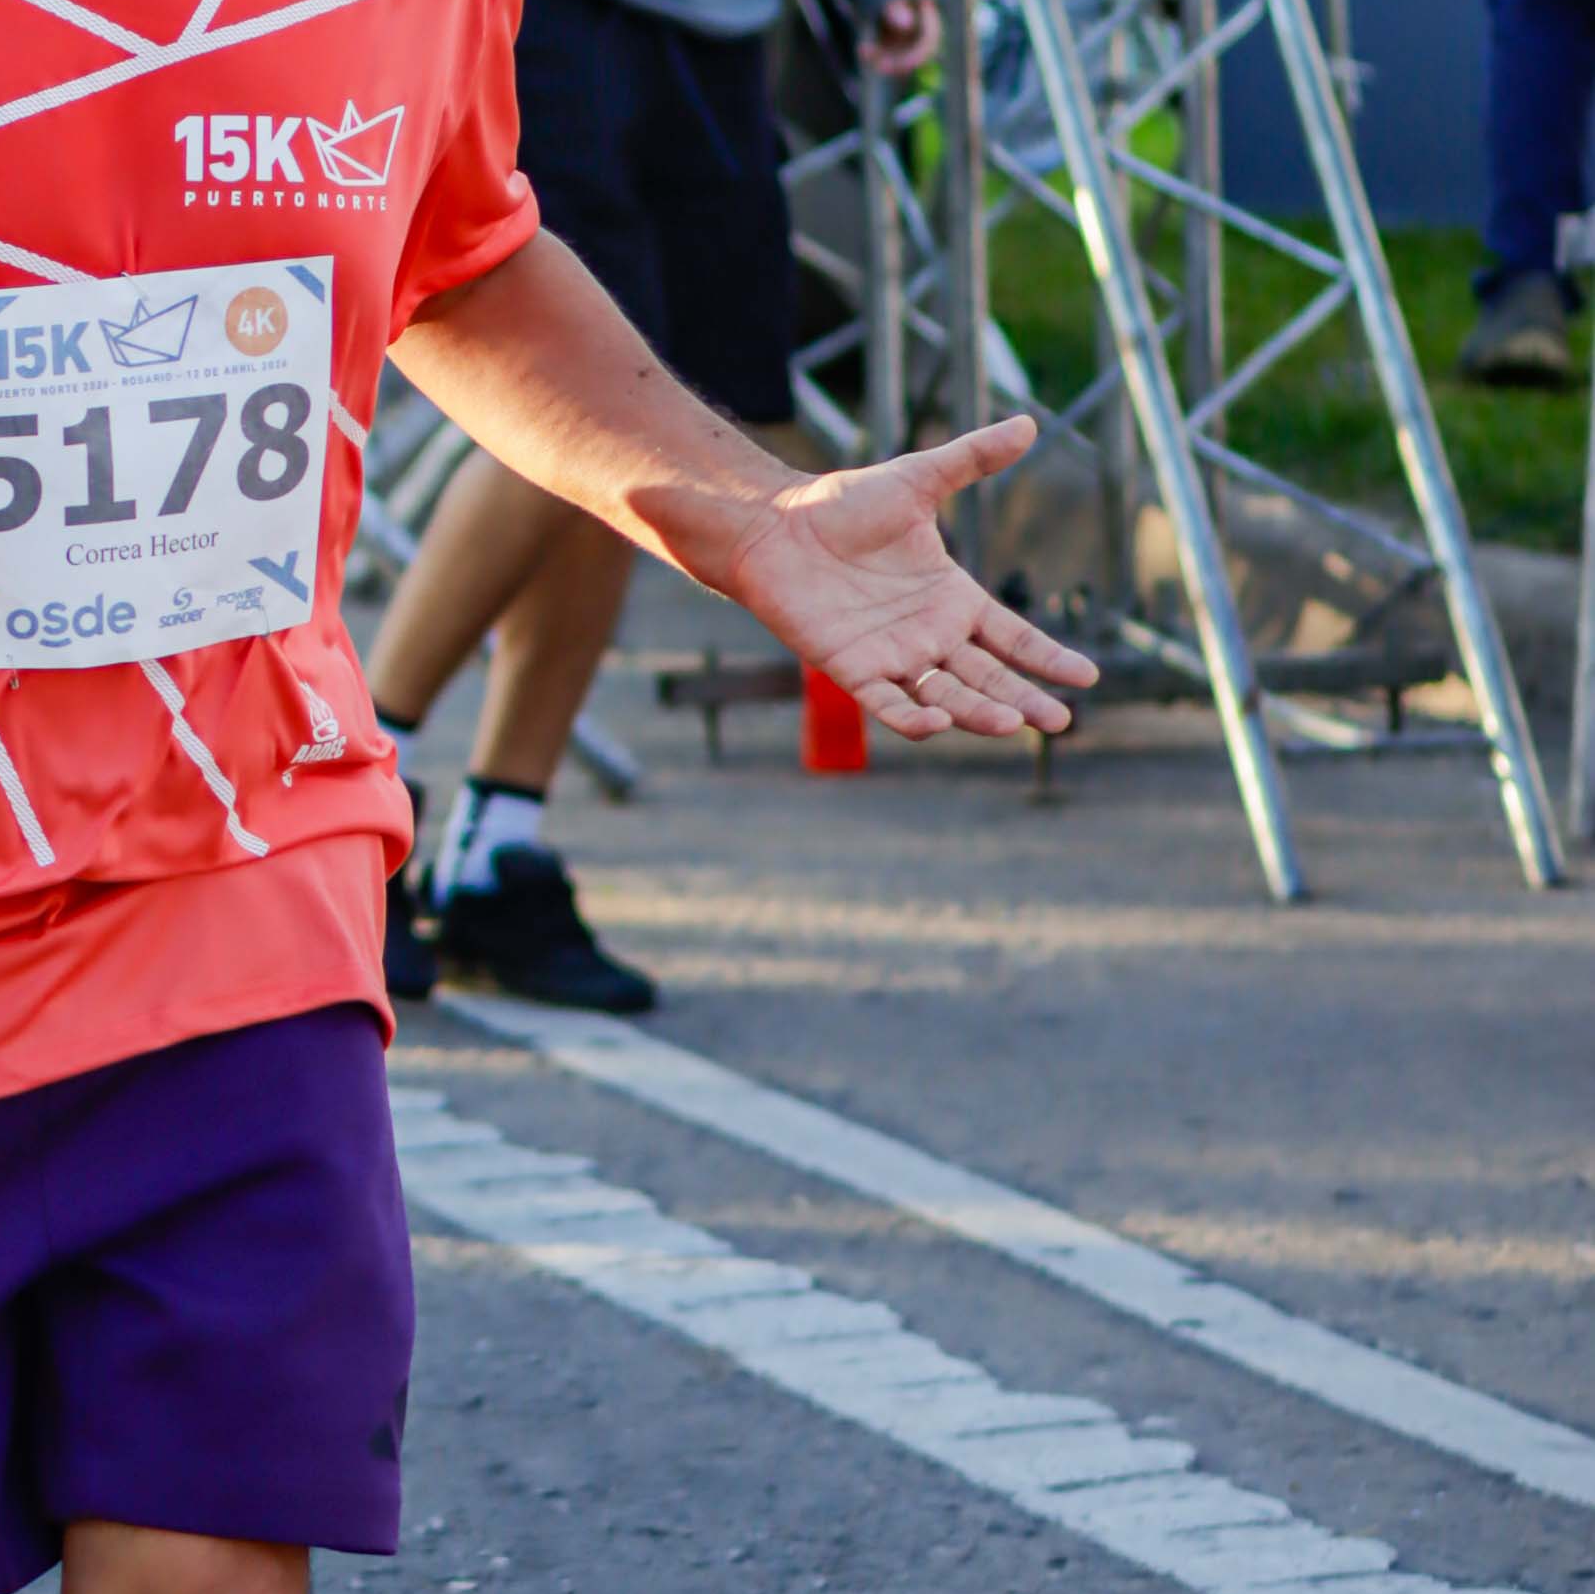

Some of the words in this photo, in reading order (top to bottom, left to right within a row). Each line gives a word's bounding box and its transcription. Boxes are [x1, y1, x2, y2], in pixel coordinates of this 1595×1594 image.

[174, 115, 304, 183] 15K
[184, 190, 305, 207] PUERTO
[318, 193, 387, 211] NORTE
[238, 307, 276, 337] 4K
[40, 383, 79, 395] NORTE
[121, 372, 173, 387] ROSARIO
[206, 367, 218, 377] DE
[224, 363, 258, 375] ABRIL
[66, 542, 143, 566] Correa
[150, 531, 220, 557] Hector
[6, 593, 137, 648] osde
